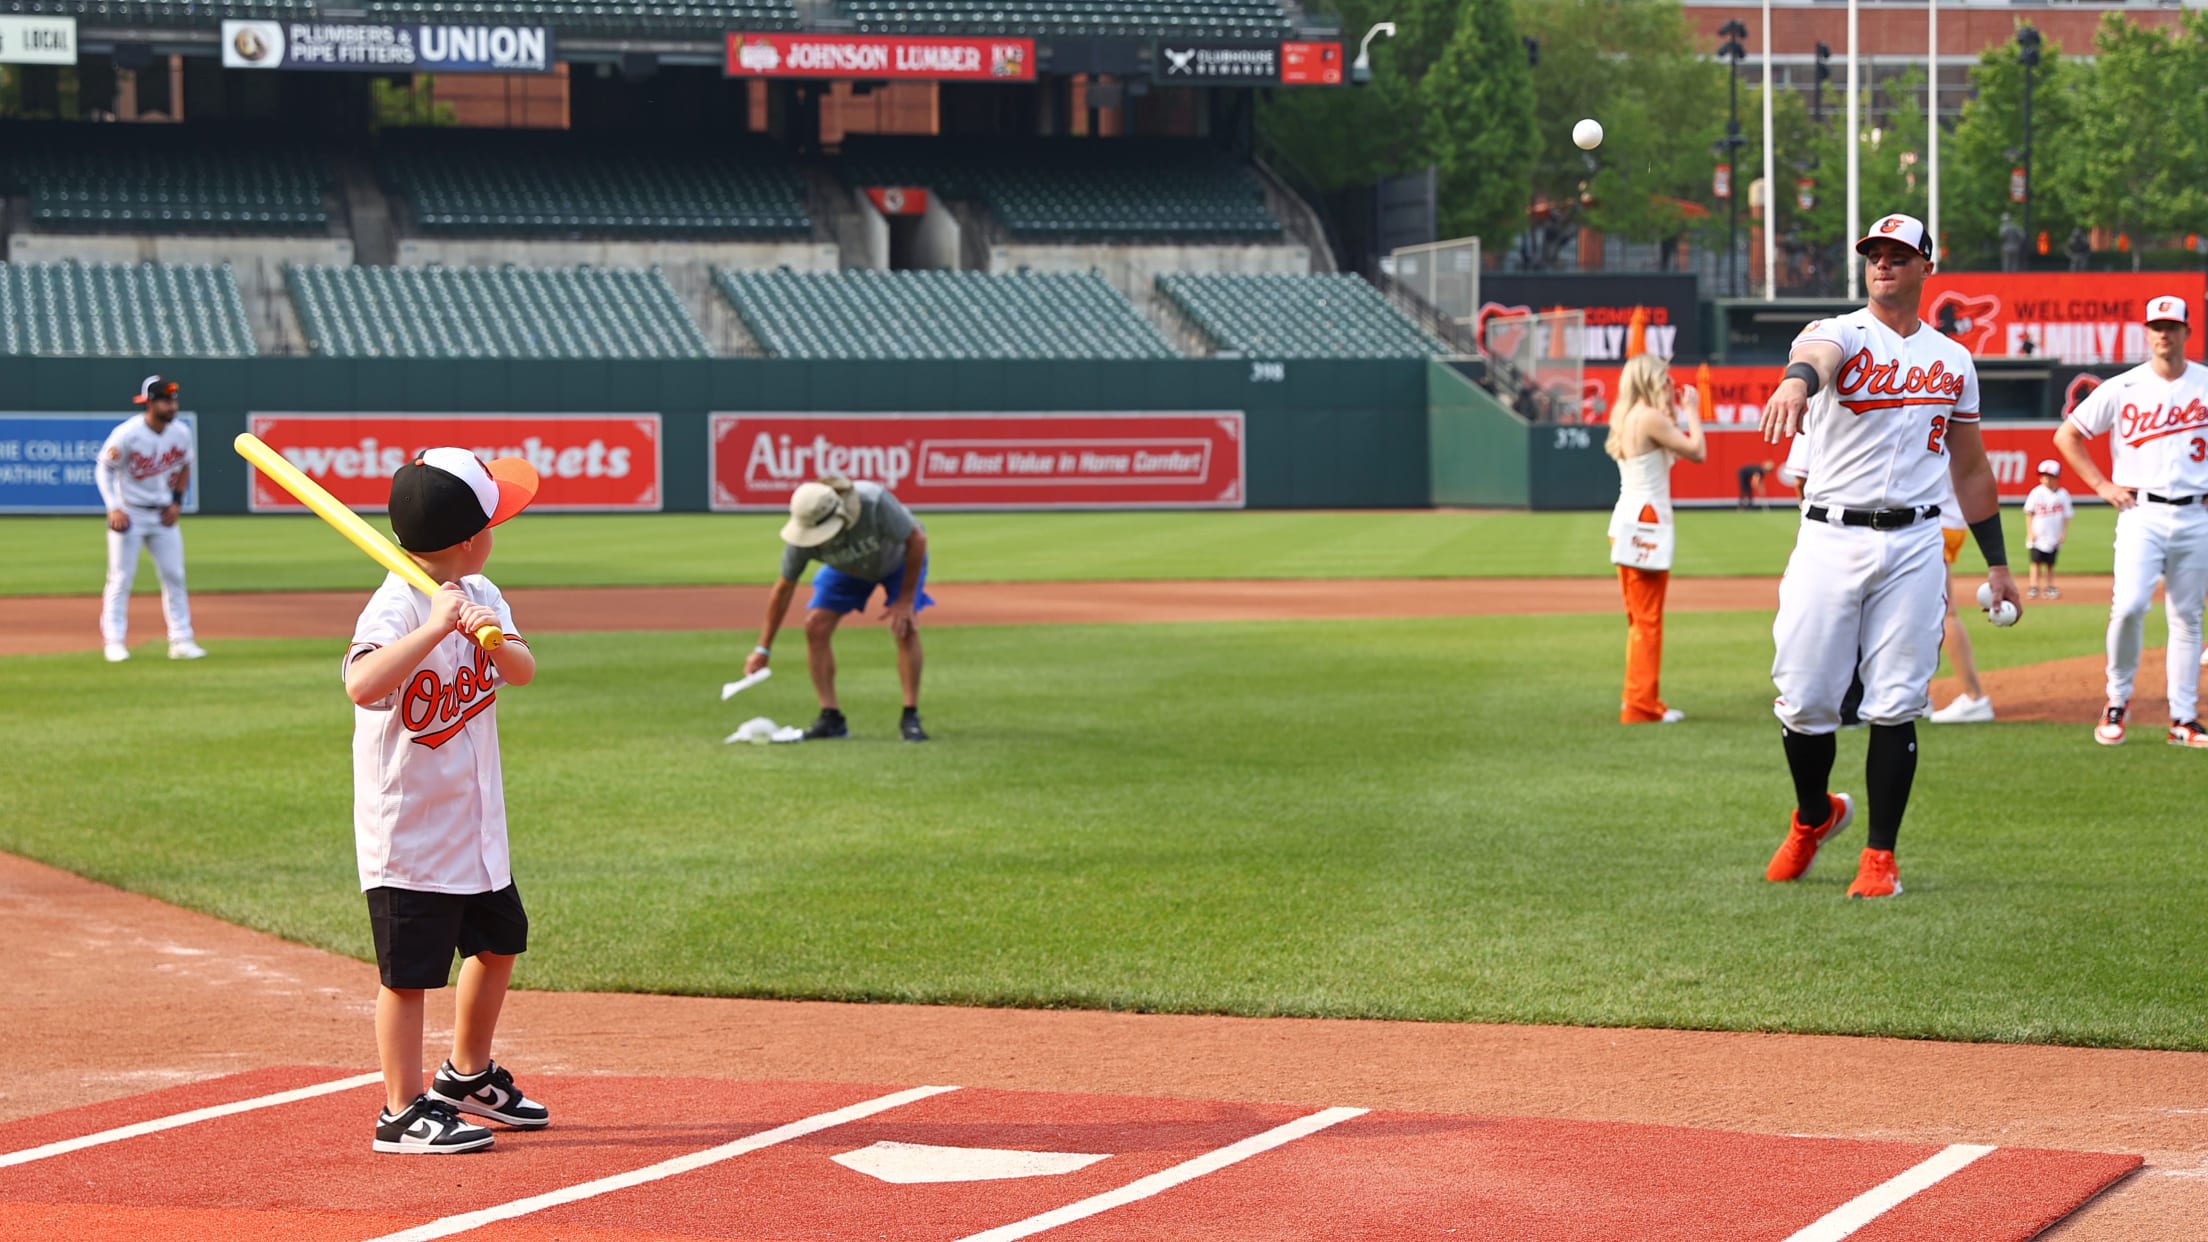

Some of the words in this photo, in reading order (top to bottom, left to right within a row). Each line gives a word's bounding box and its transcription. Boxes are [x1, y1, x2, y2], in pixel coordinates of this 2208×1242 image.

[23, 29, 68, 50] LOCAL
[290, 23, 394, 43] PLUMBERS
[419, 25, 546, 62] UNION
[290, 44, 336, 62] PIPE
[338, 44, 416, 63] FITTERS
[786, 43, 889, 70] JOHNSON
[895, 45, 981, 71] LUMBER
[1196, 50, 1276, 65] CLUBHOUSE
[2014, 301, 2135, 322] WELCOME
[1535, 325, 1625, 360] FMILY
[1250, 361, 1285, 382] 398
[1836, 346, 1964, 398] Orioles
[1553, 427, 1590, 449] 376
[24, 439, 104, 462] COLLEG
[281, 437, 407, 479] weis
[745, 431, 911, 489] Airtemp
[928, 452, 959, 474] The
[962, 451, 1003, 474] Best
[1006, 451, 1055, 474] Value
[1079, 451, 1130, 473] Home
[1132, 450, 1203, 473] Comfort
